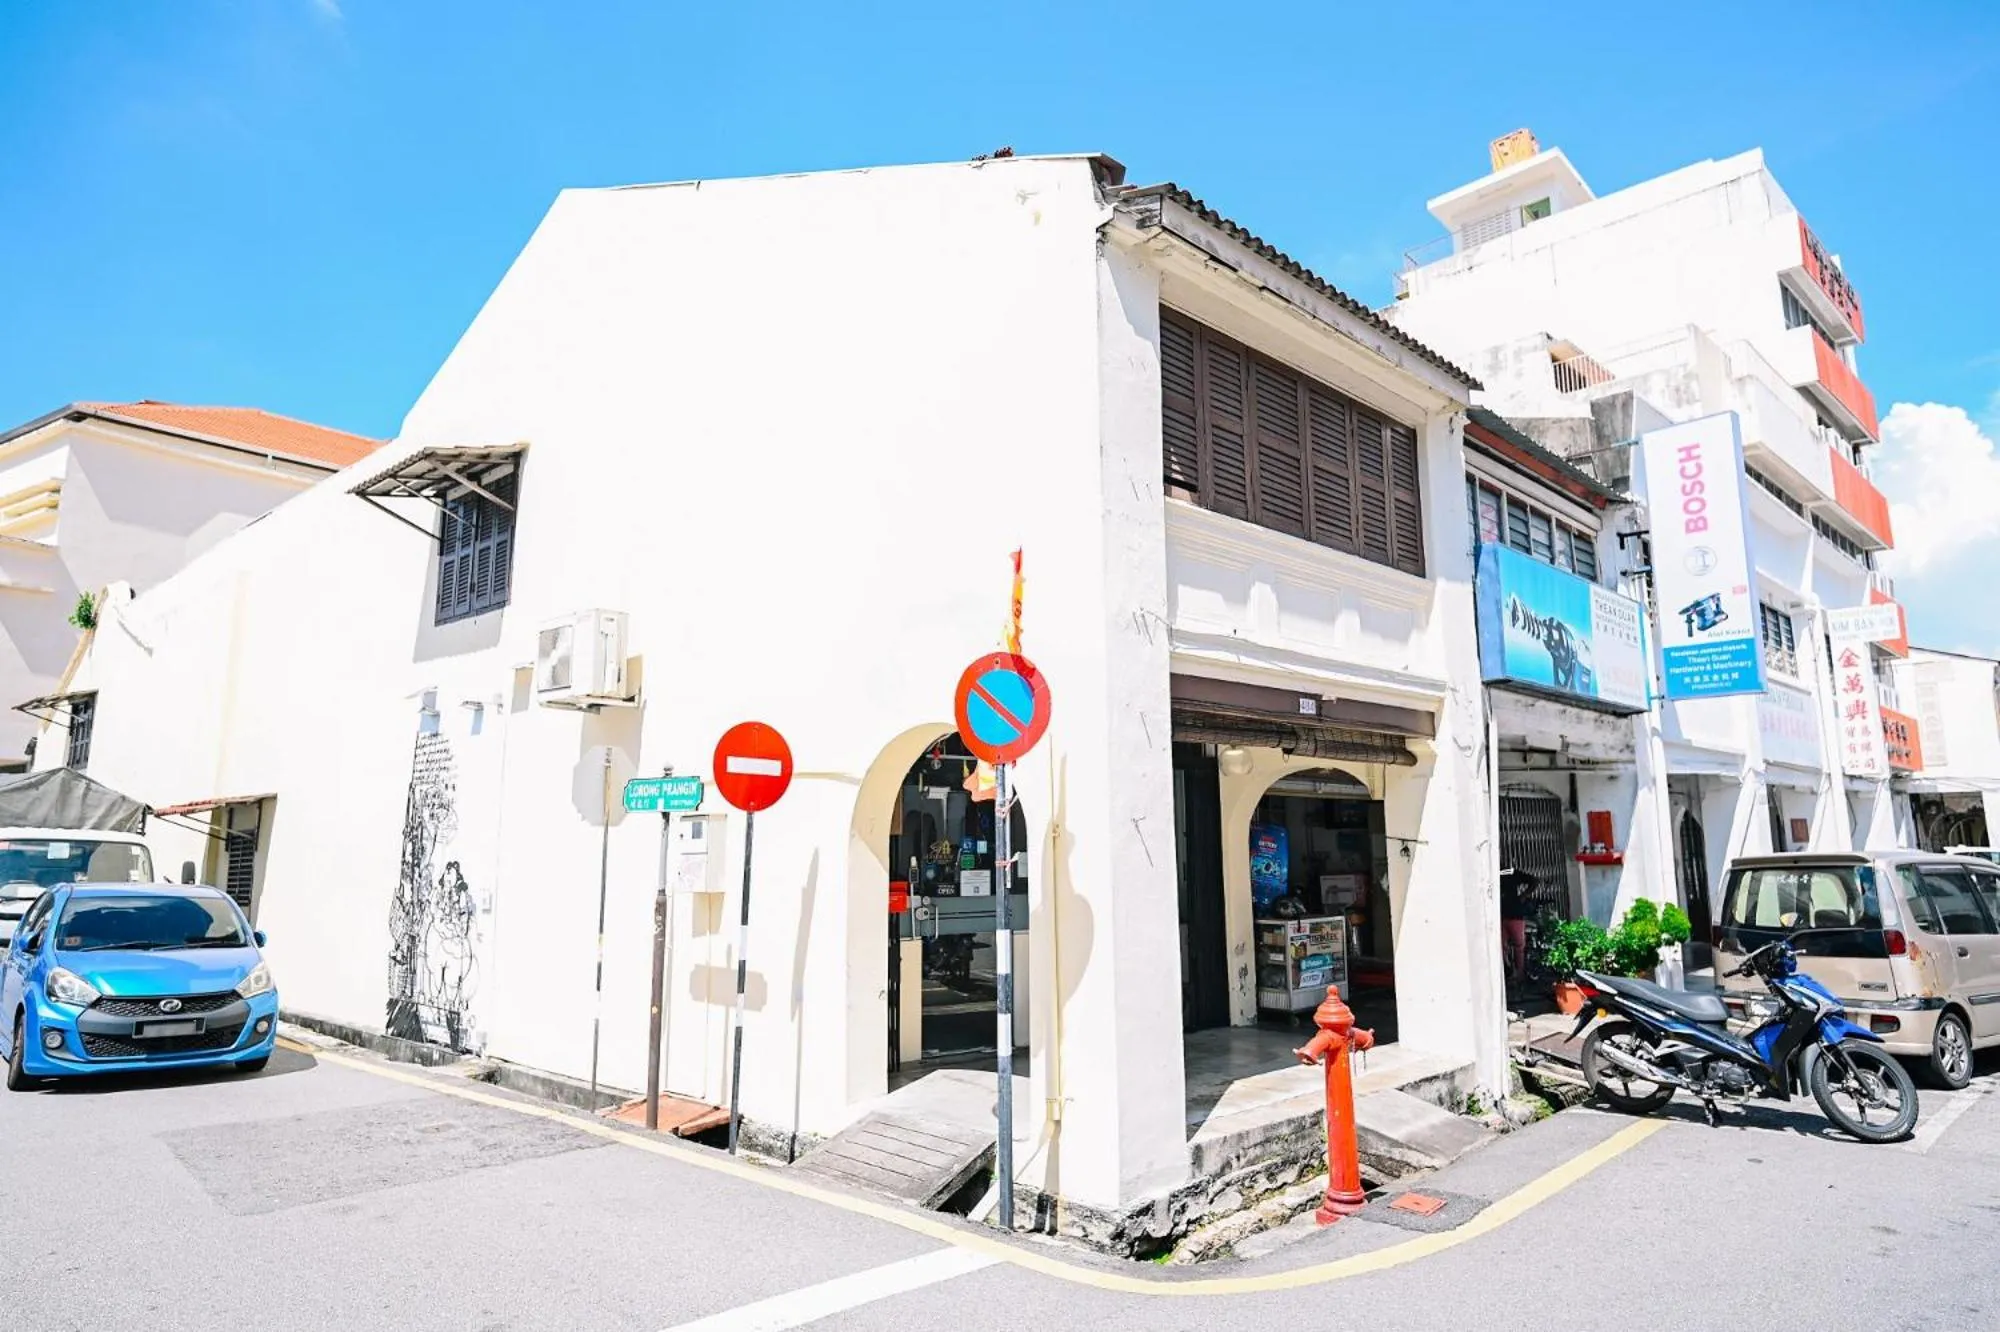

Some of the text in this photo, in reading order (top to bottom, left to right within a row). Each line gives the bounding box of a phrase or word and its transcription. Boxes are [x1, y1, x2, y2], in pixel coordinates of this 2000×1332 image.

[1678, 443, 1708, 535] BOSCH
[1670, 666, 1704, 674] Hardware
[1713, 660, 1751, 669] Machinery
